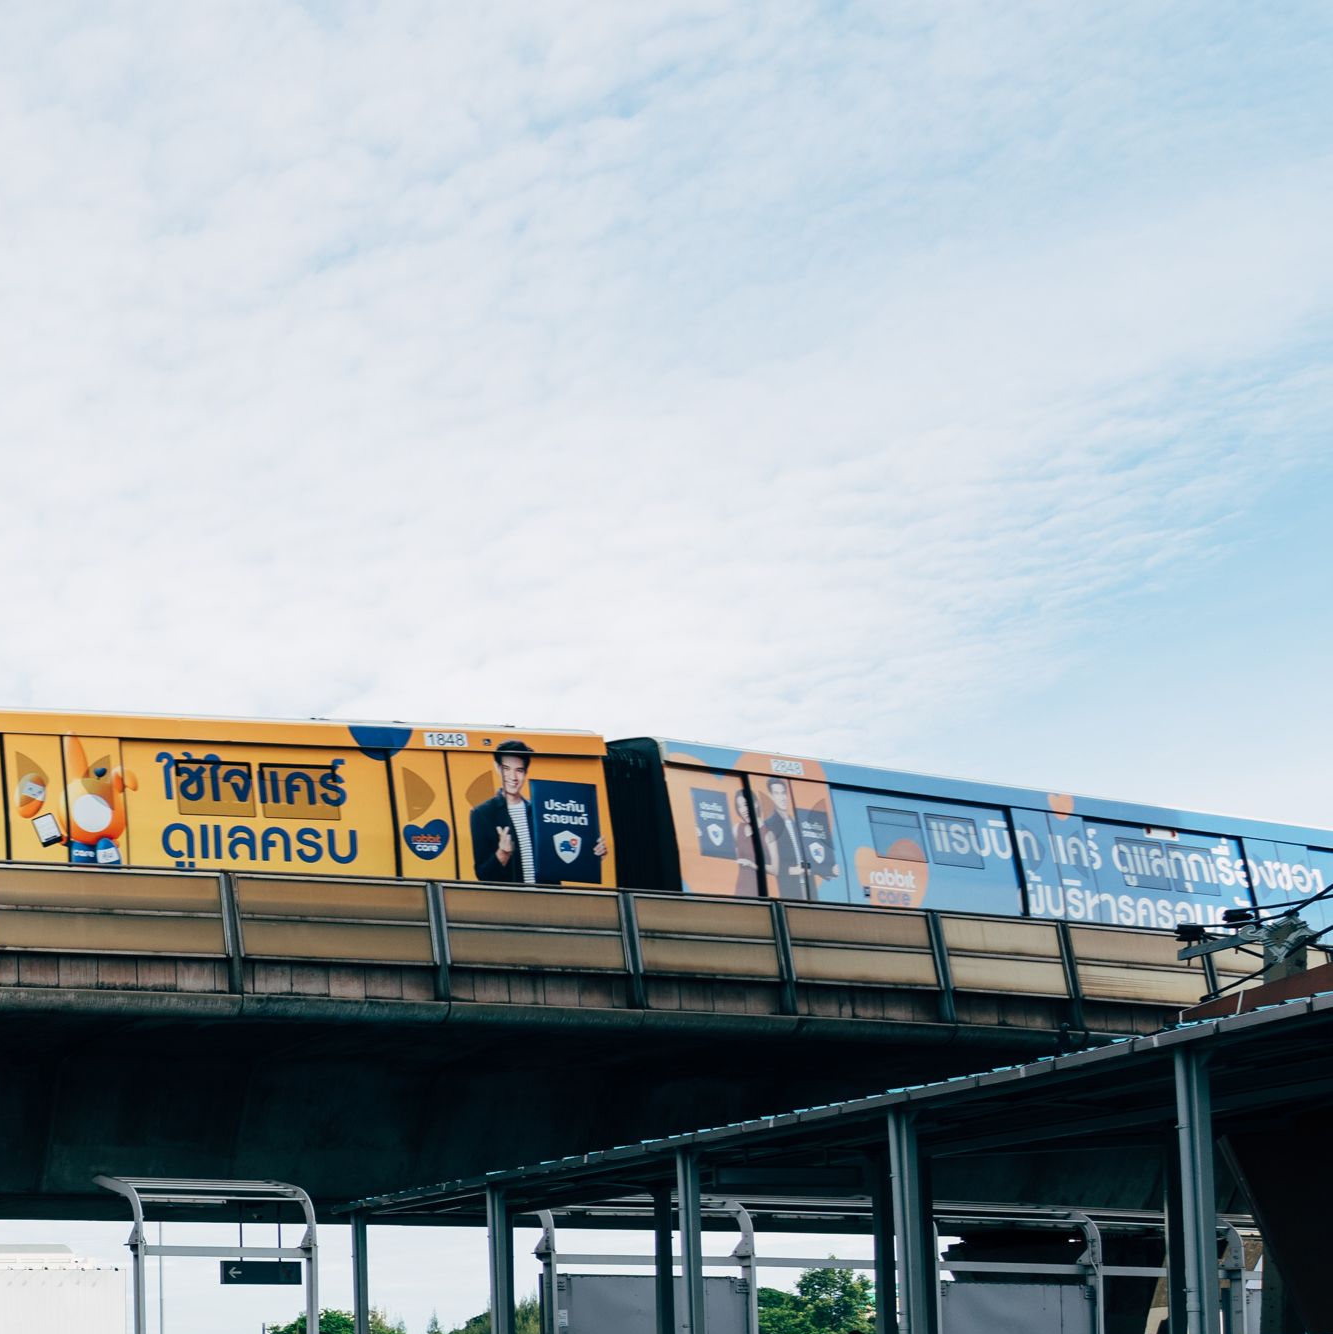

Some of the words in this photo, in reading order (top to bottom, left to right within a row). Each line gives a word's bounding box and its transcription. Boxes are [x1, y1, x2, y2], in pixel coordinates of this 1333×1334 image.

[427, 733, 466, 747] 1848
[544, 799, 585, 813] ประกัน
[542, 813, 588, 826] รถยนต์
[411, 834, 441, 843] rabbit
[162, 823, 358, 870] ดูแลครบ
[415, 844, 439, 853] care
[869, 869, 916, 889] rabbit
